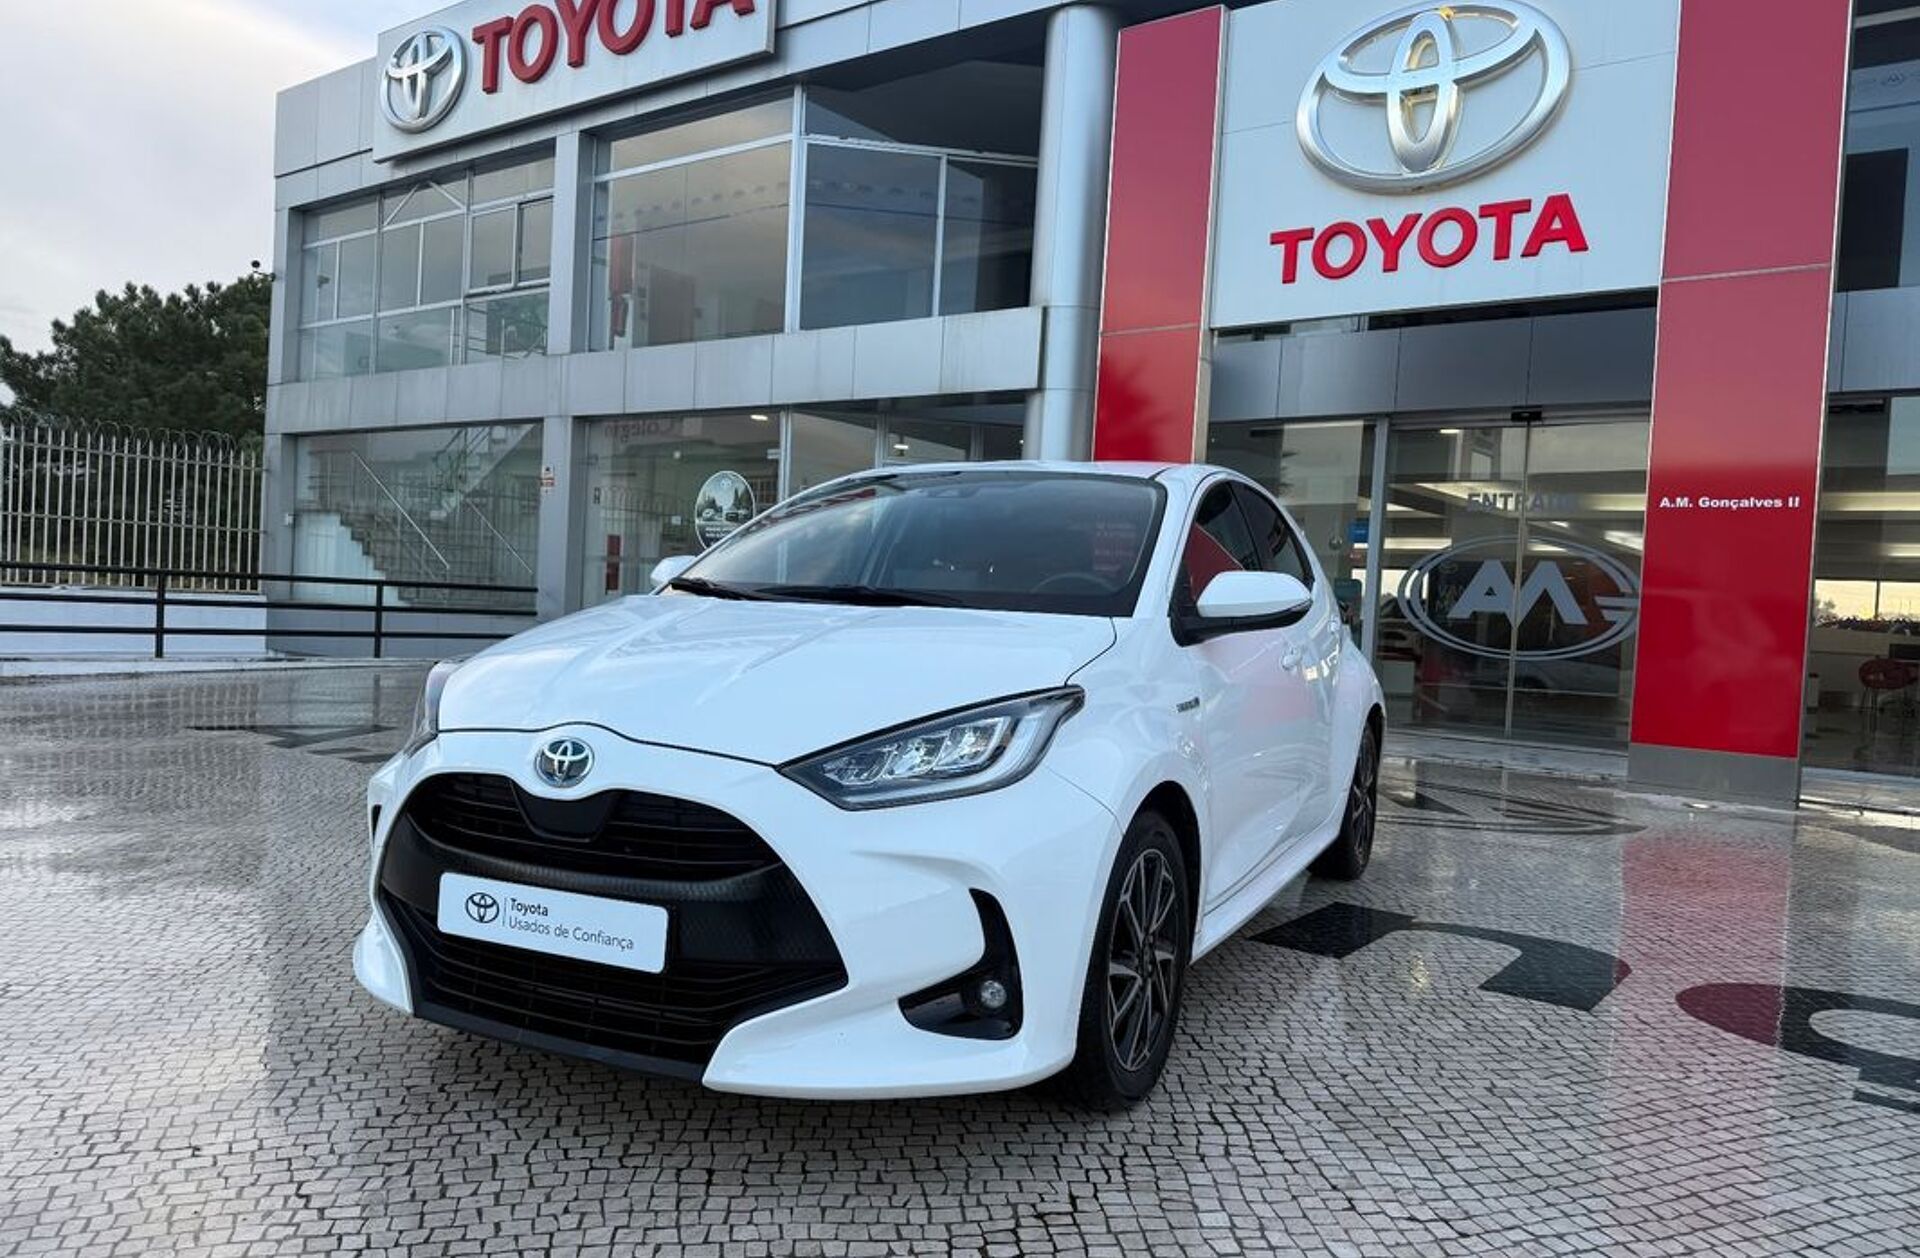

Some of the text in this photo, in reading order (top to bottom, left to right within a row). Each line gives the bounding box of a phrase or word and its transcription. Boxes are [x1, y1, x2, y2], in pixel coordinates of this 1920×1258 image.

[1270, 193, 1589, 284] TOYOTA
[1466, 492, 1580, 513] ENTRA
[1659, 496, 1801, 510] A.M. Gonçalves II
[510, 897, 549, 917] Toyota
[509, 915, 635, 952] Usados de Confiança
